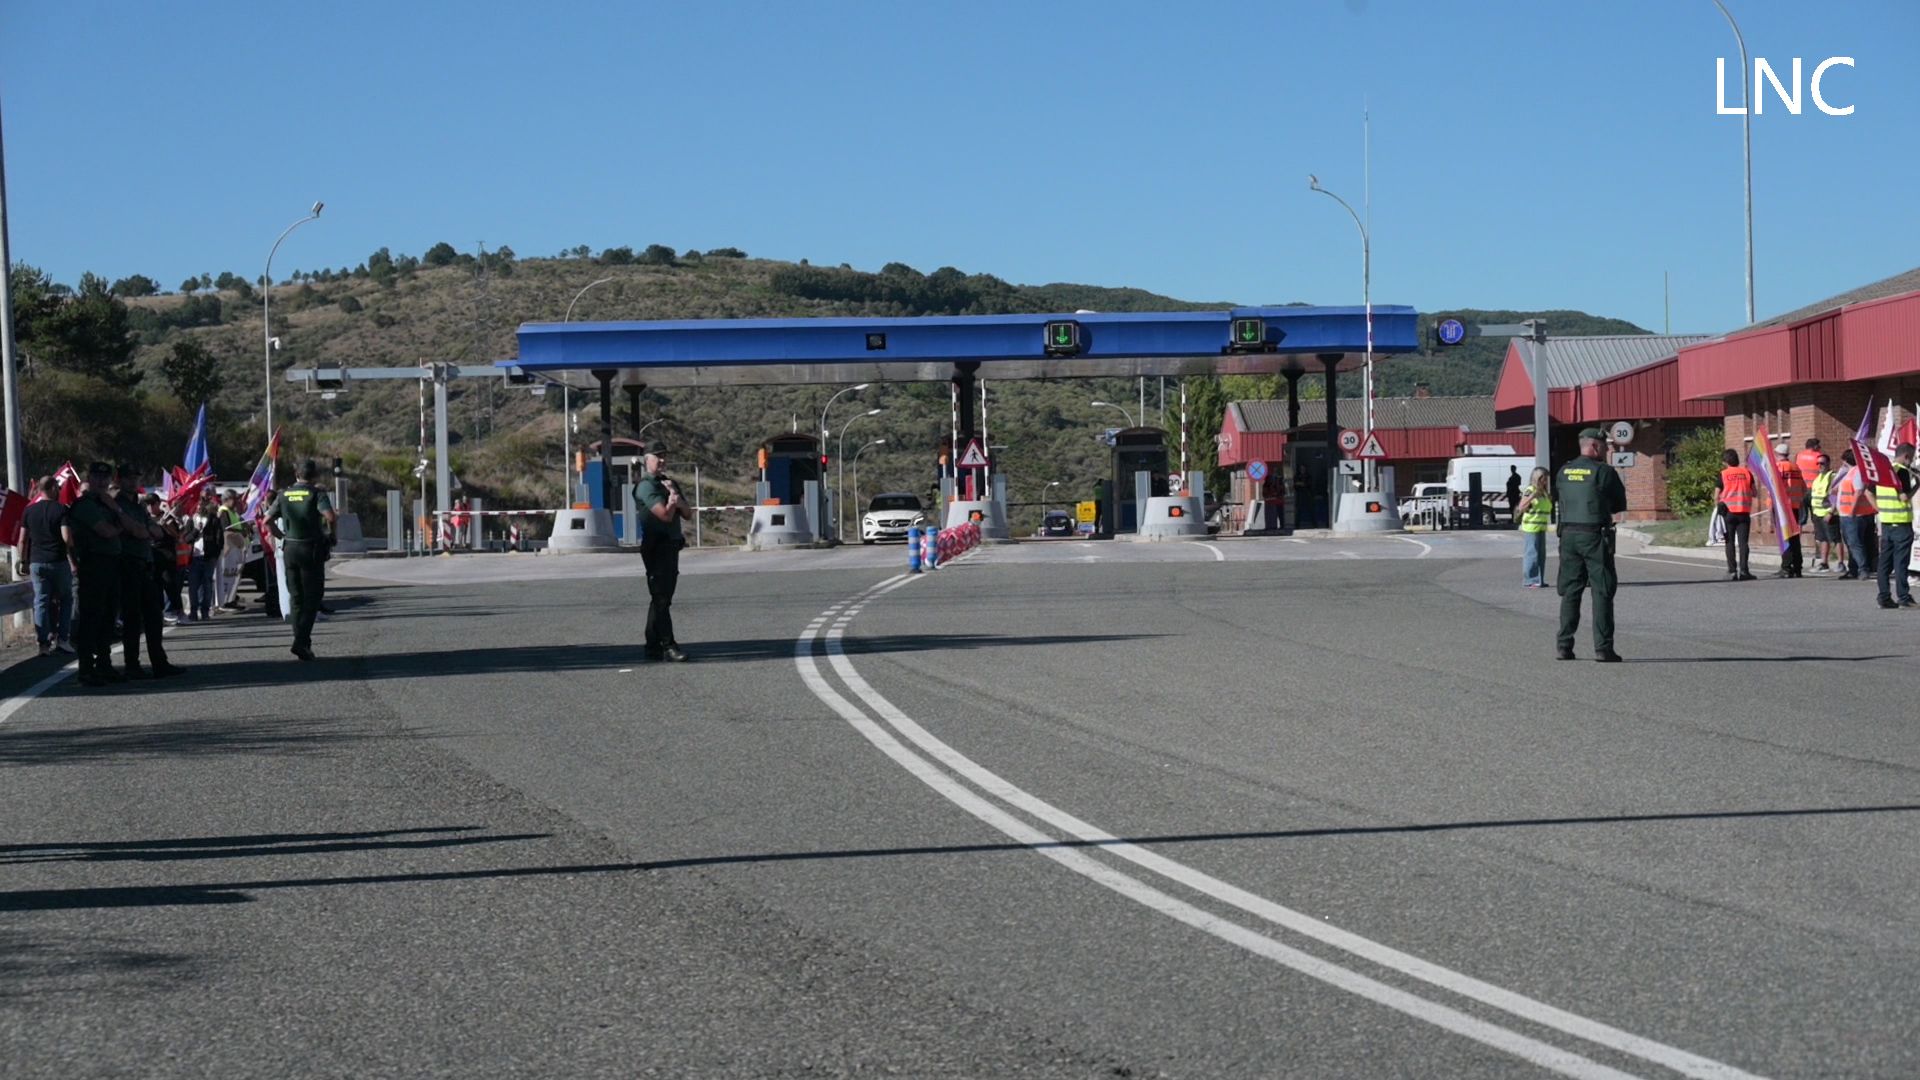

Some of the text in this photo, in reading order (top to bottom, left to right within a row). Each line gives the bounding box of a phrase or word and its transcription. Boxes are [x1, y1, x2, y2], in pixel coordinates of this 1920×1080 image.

[1616, 429, 1628, 438] 30
[1344, 436, 1356, 445] 30
[1856, 442, 1880, 482] CCOO
